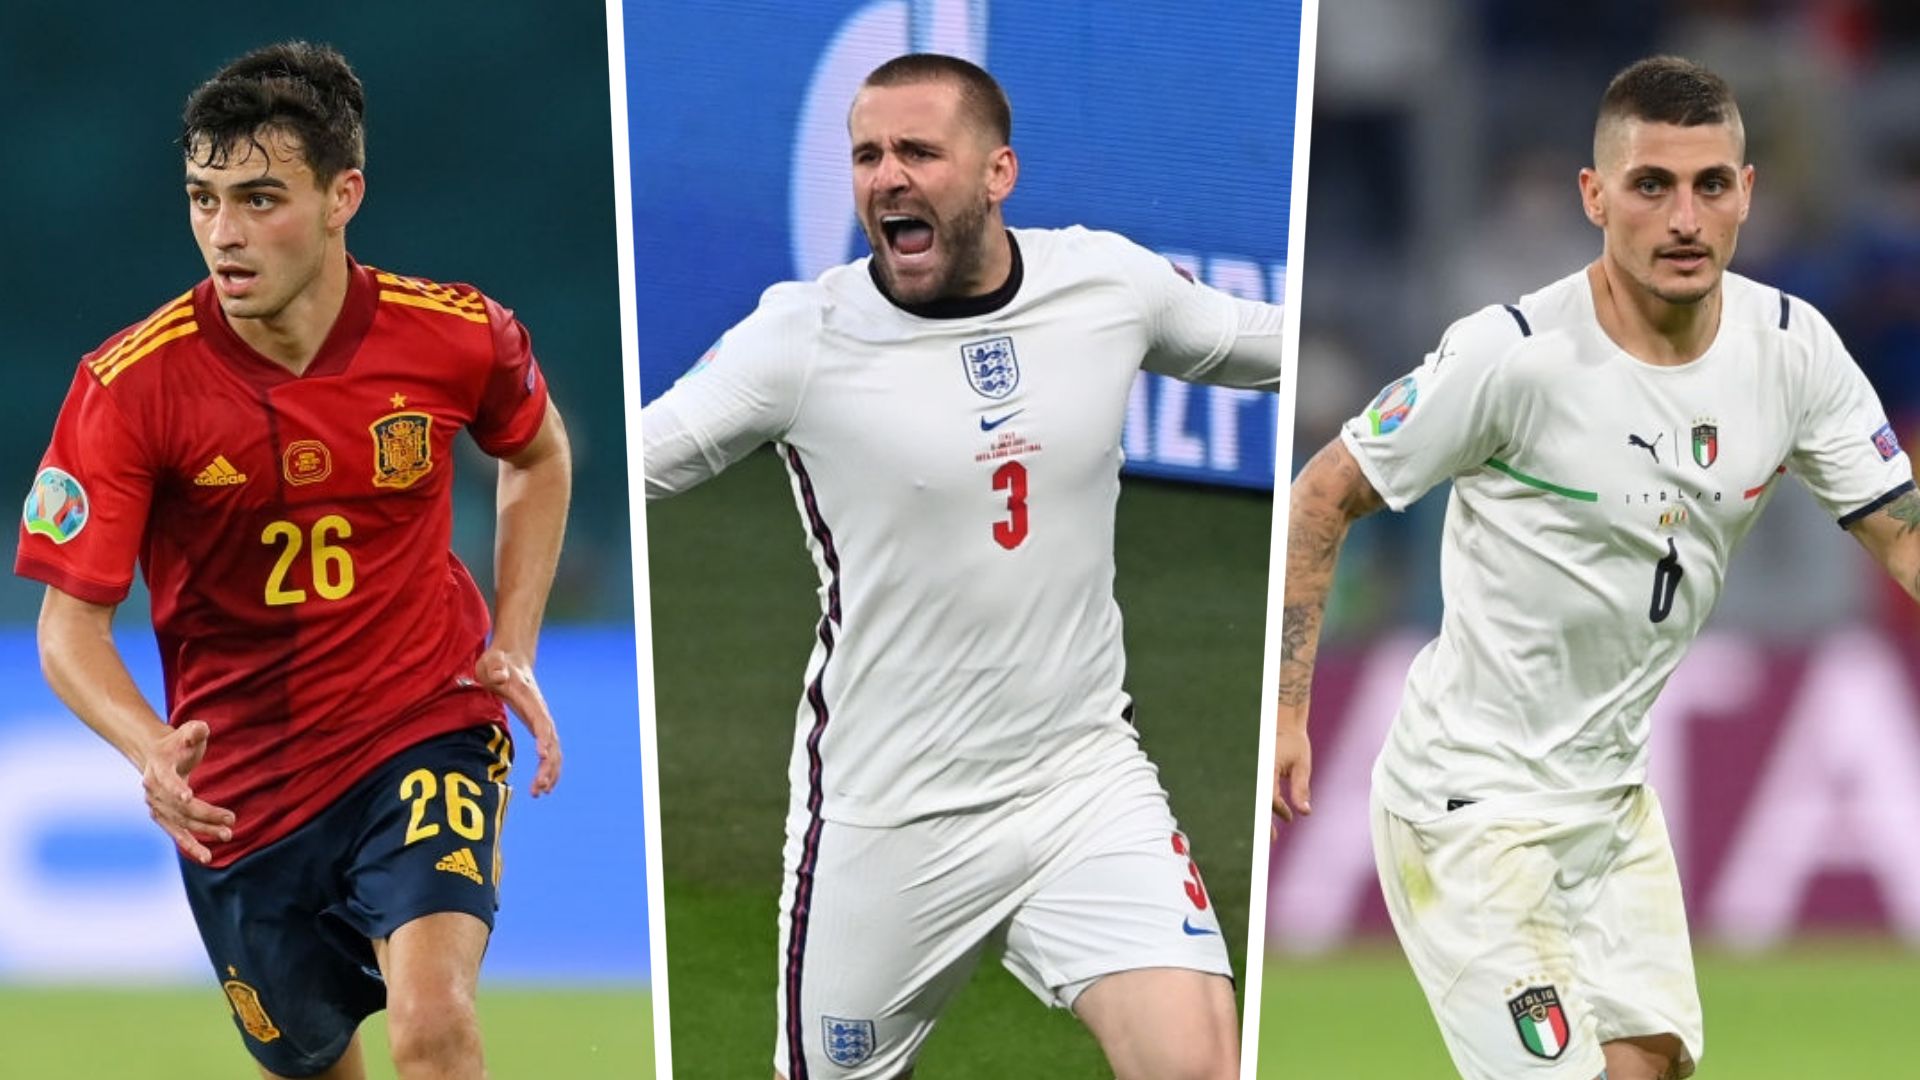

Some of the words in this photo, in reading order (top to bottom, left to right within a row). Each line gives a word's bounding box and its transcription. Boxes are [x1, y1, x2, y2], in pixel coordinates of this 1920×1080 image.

[194, 473, 248, 486] adidas
[992, 460, 1028, 550] 3
[261, 515, 355, 606] 26
[1649, 537, 1683, 623] 6
[400, 768, 485, 846] 26
[435, 861, 484, 885] adidas
[1171, 831, 1208, 911] 3
[1512, 989, 1555, 1013] ITALIA
